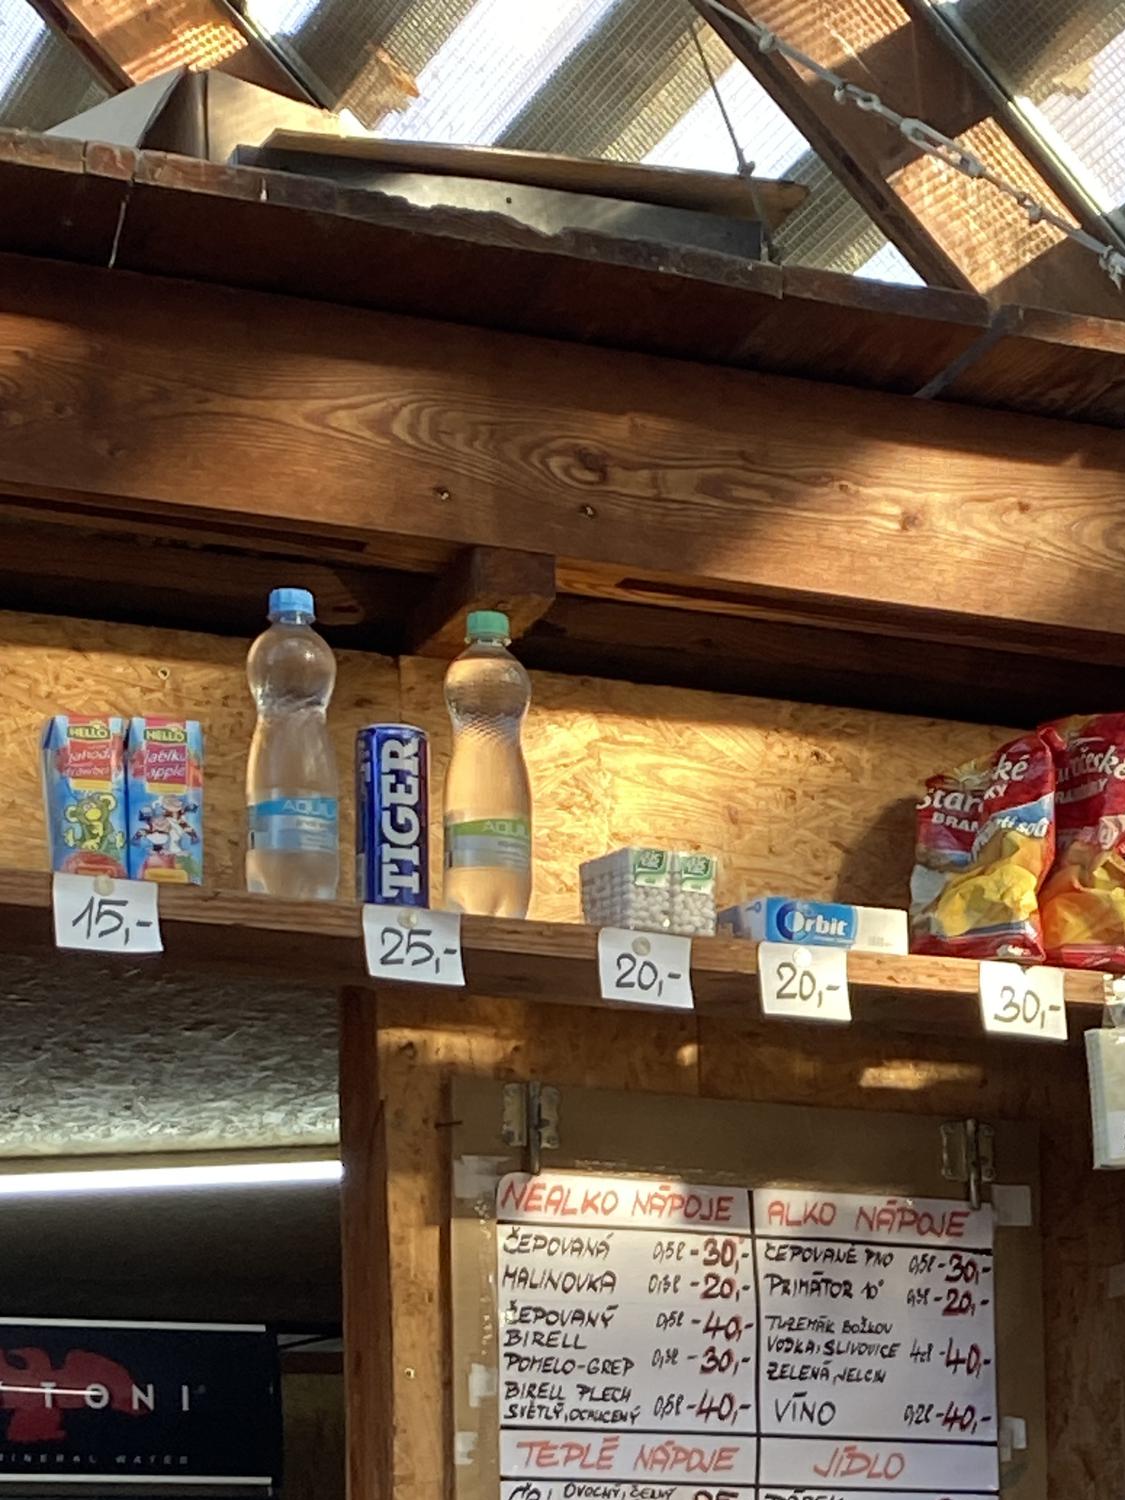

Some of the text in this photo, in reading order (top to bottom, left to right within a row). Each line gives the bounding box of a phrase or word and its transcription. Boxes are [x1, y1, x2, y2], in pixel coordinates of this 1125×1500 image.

[69, 726, 108, 739] HELLO
[146, 730, 185, 742] HELLO
[381, 736, 420, 898] TIGER
[72, 896, 152, 945] 15,-
[776, 902, 848, 939] Orbit
[380, 927, 457, 974] 25,-
[615, 953, 681, 996] 20,-
[776, 962, 840, 1008] 20,-
[994, 986, 1061, 1030] 30,-
[500, 1181, 734, 1222] NEALKO NÁPOJE
[768, 1200, 970, 1238] ALKO NÁPOJE
[503, 1227, 614, 1260] ČEPOVANÁ
[764, 1270, 853, 1299] PRIMÁTOR
[503, 1329, 587, 1350] BIRELL
[775, 1391, 836, 1425] VÍNO
[517, 1435, 739, 1473] TEPLÉ NÁPOJE
[813, 1445, 906, 1480] JÍDLO
